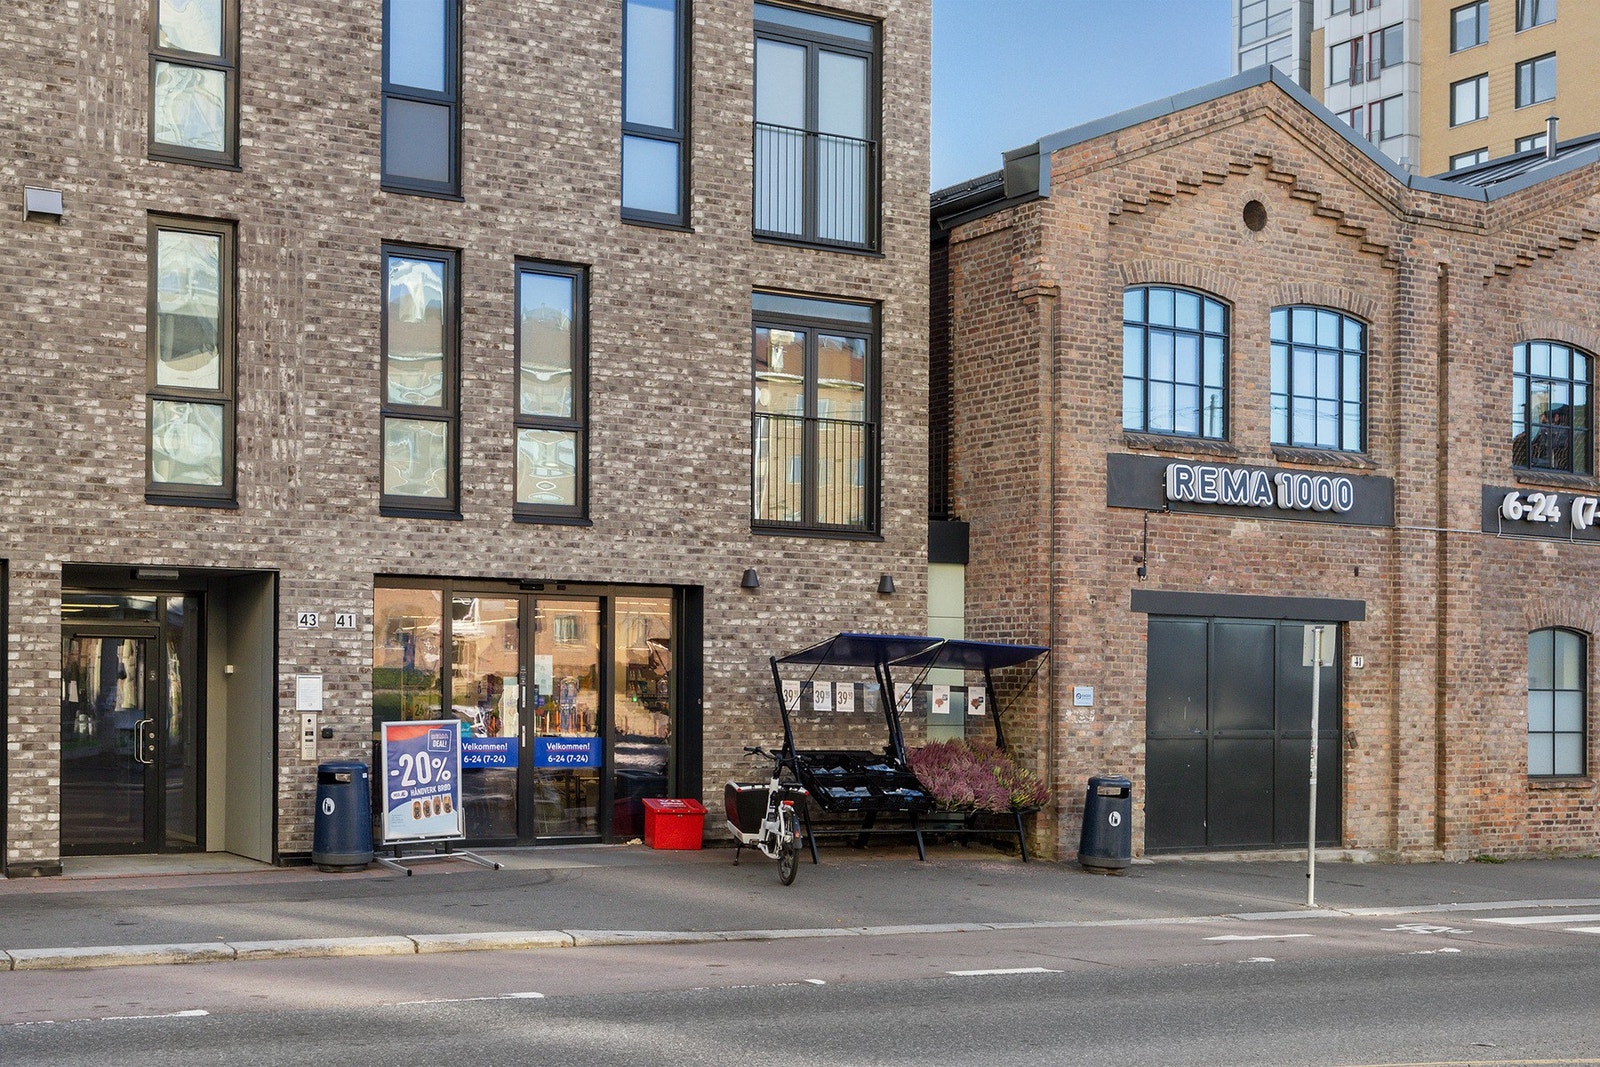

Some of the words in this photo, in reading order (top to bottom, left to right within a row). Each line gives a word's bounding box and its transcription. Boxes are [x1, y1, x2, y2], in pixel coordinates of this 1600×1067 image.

[1167, 463, 1274, 508] REMA
[1274, 472, 1354, 513] 1000
[1502, 491, 1561, 522] 6-24
[299, 613, 317, 626] 43
[336, 614, 353, 627] 41
[783, 688, 794, 703] 39
[814, 690, 825, 704] 39
[837, 691, 848, 705] 39
[462, 742, 508, 751] Velkommen!
[546, 742, 590, 751] Velkommen!
[463, 755, 481, 763] 6-24
[483, 754, 506, 764] (7-24)
[547, 754, 565, 763] 6-24
[566, 754, 589, 764] (7-24)
[390, 751, 452, 787] -20%
